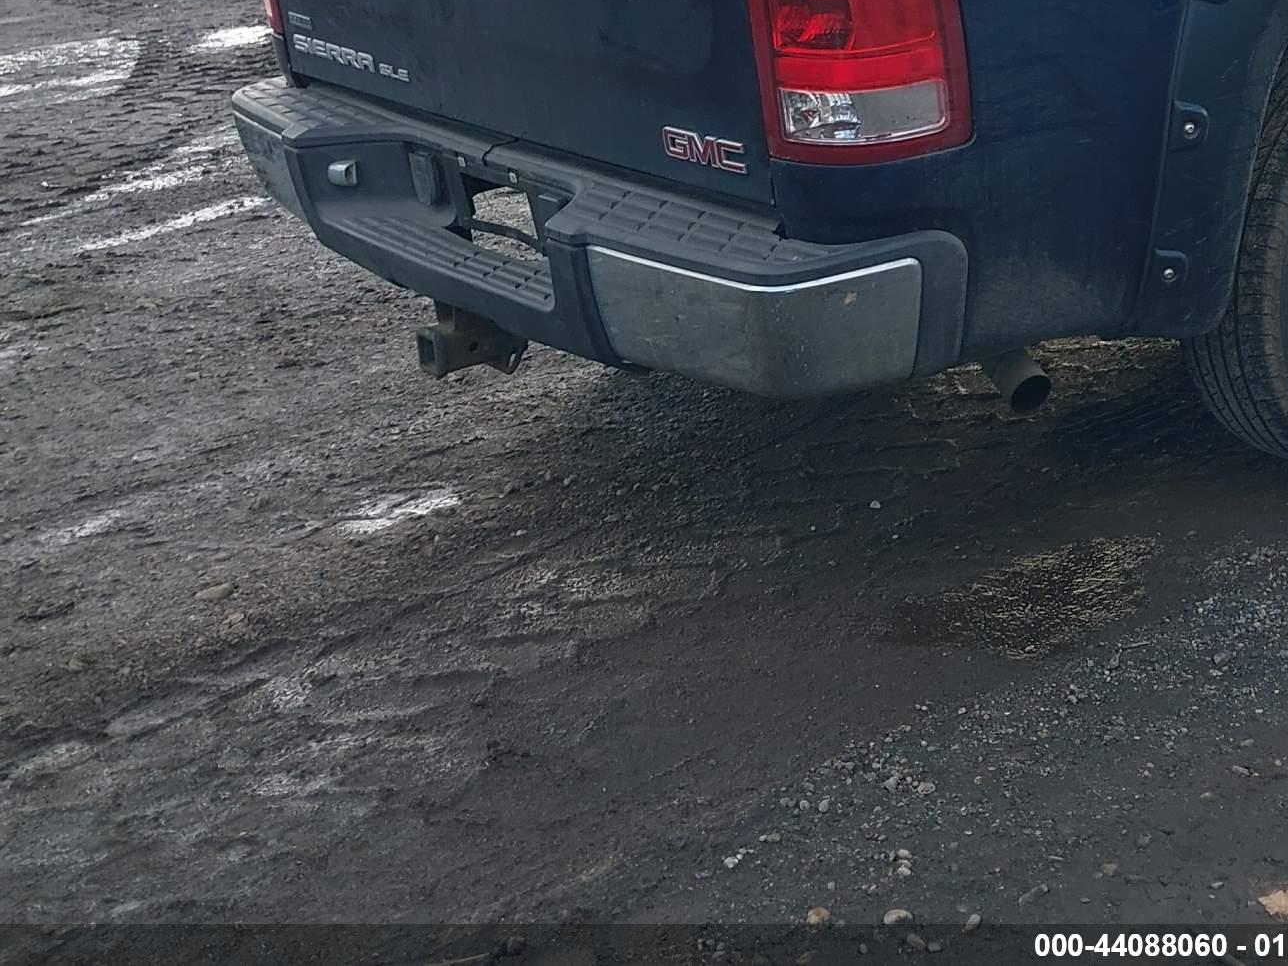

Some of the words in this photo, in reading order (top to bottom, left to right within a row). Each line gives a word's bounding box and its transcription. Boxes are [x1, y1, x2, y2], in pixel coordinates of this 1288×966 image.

[292, 34, 376, 73] SIERRA
[378, 62, 410, 83] SLE
[662, 126, 747, 174] GMC
